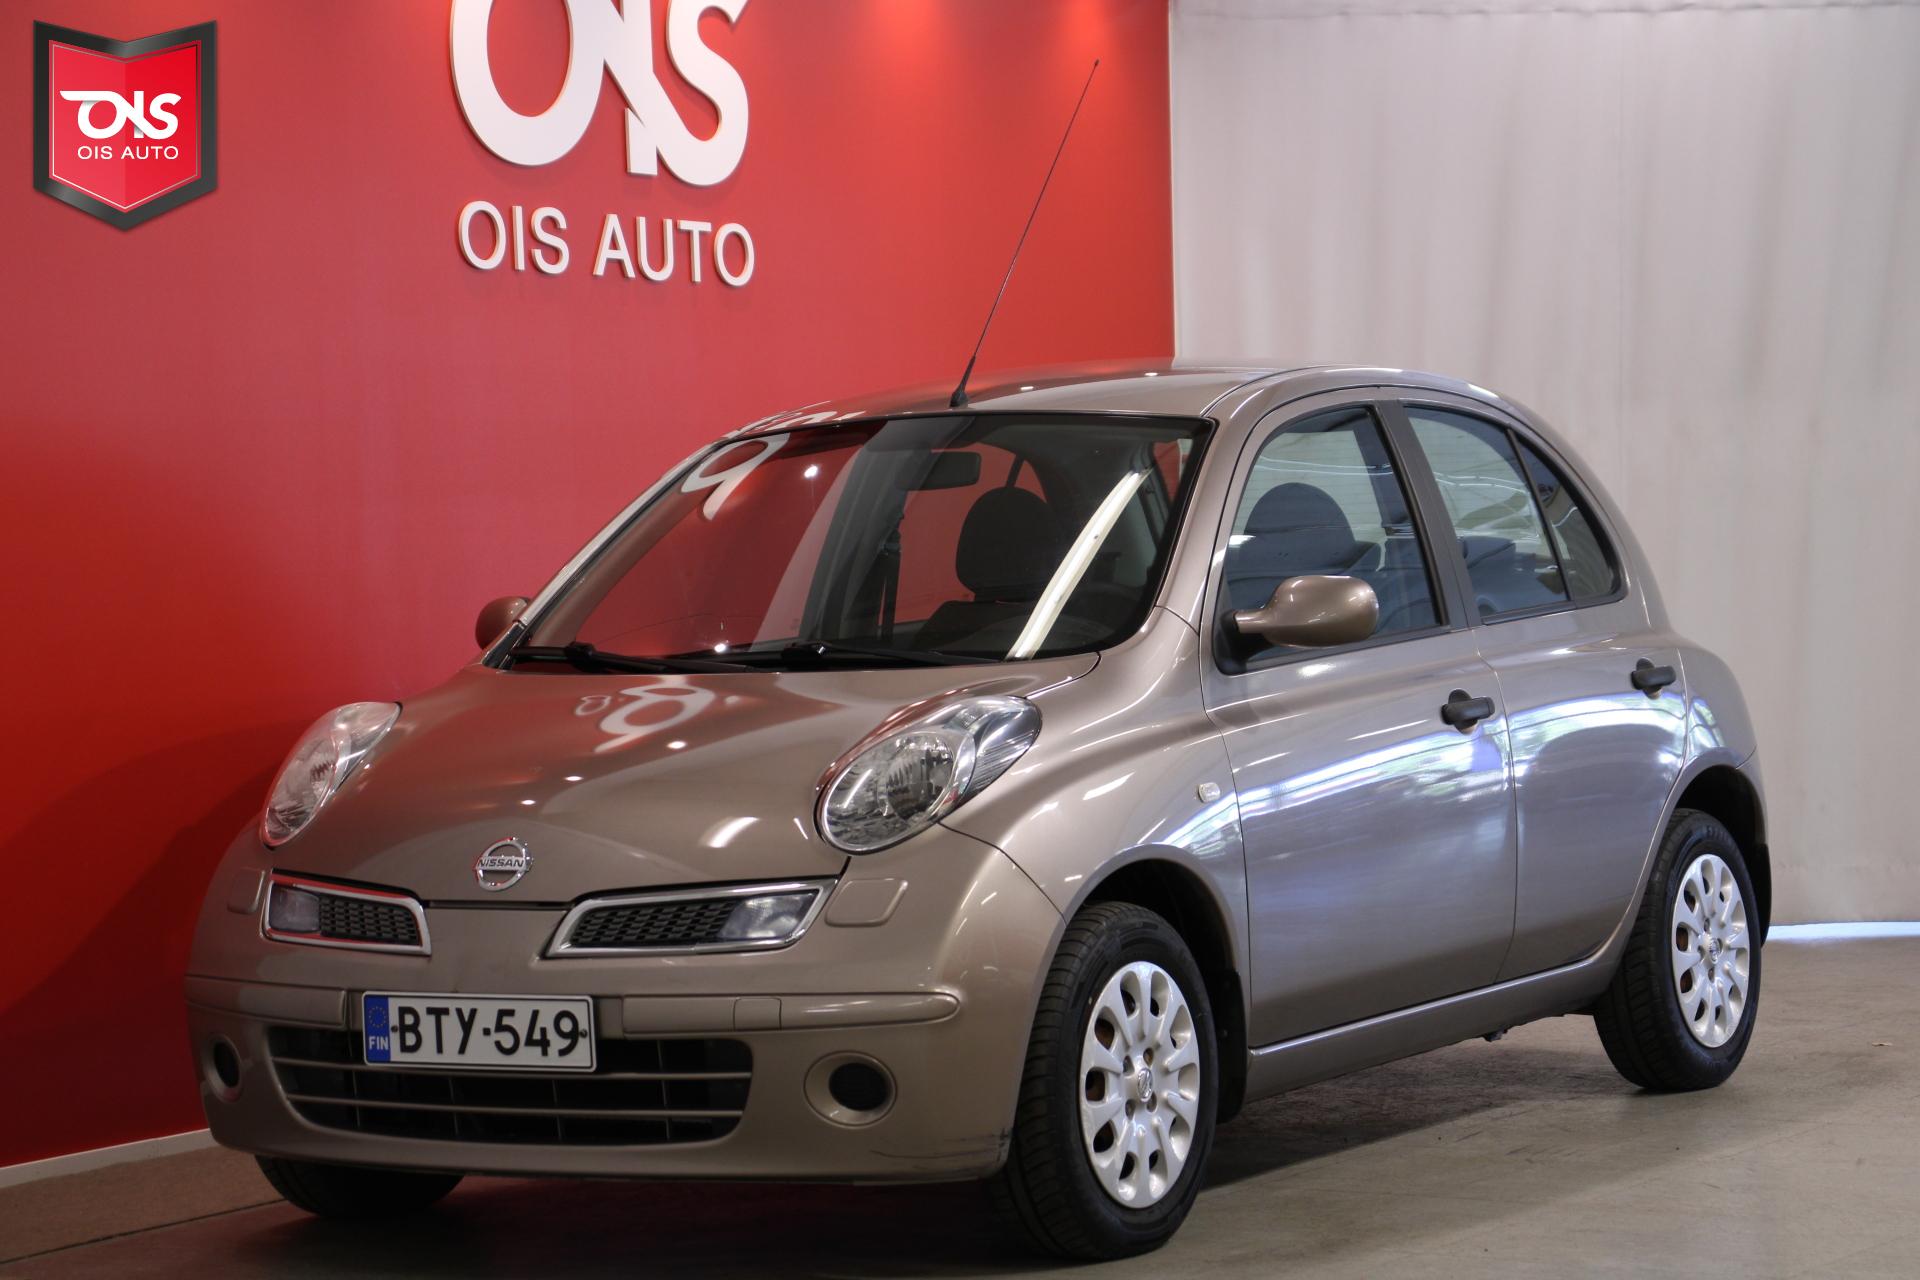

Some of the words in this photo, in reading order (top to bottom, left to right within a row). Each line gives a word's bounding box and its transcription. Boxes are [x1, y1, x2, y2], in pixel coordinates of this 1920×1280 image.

[459, 200, 570, 275] OIS
[594, 213, 755, 287] AUTO
[478, 858, 524, 868] NISSAN
[368, 1036, 389, 1051] FIN
[398, 1006, 580, 1057] BTY-549
